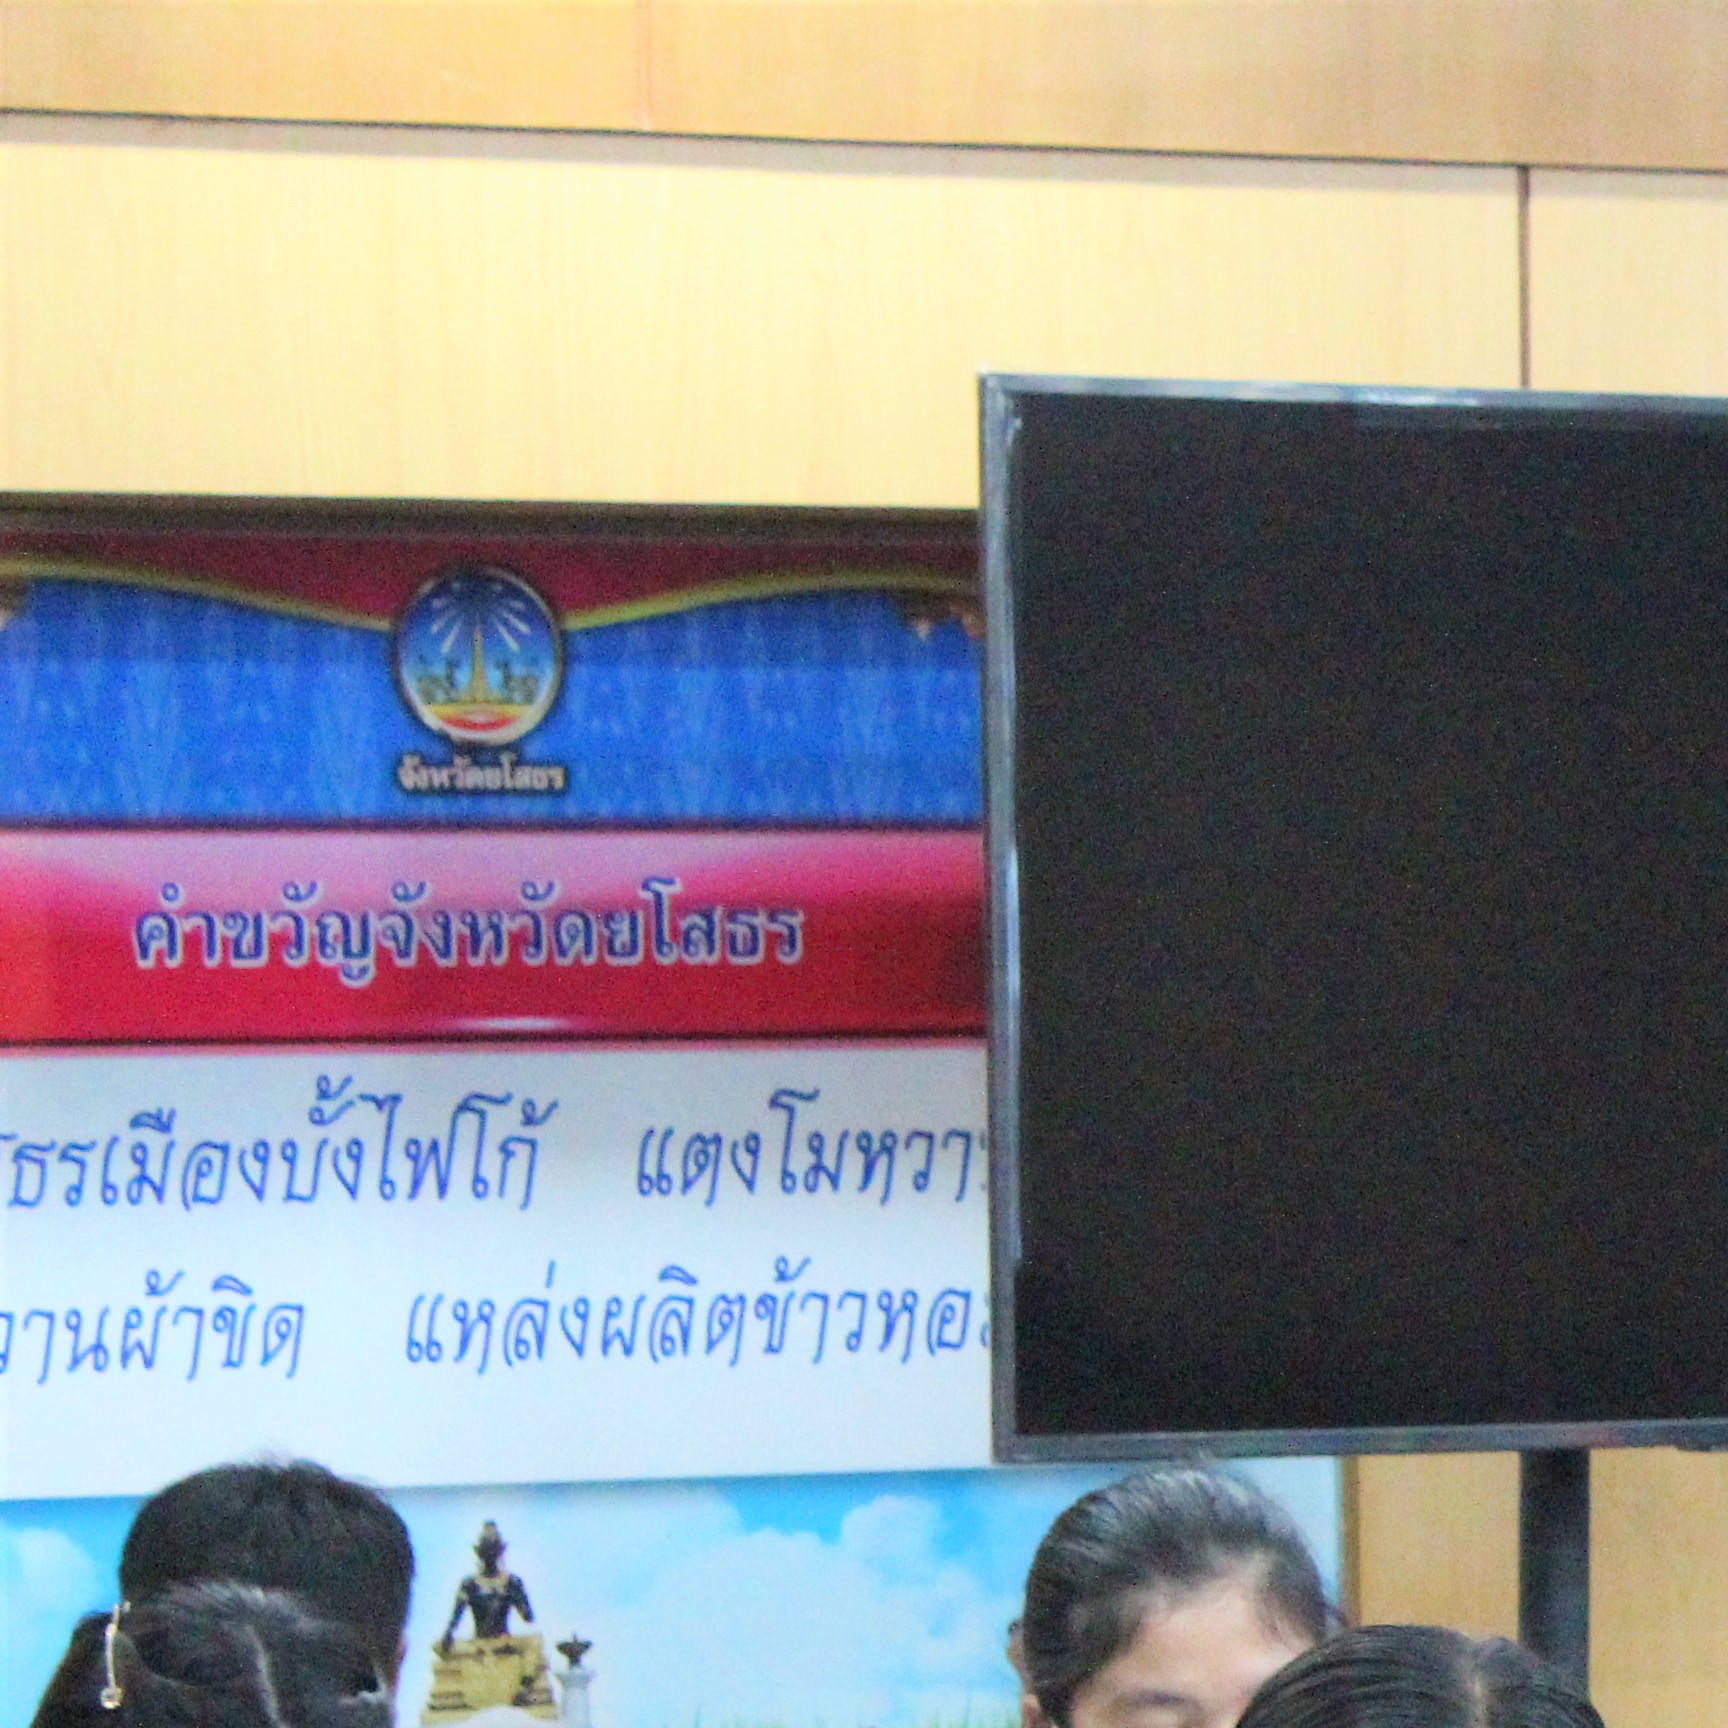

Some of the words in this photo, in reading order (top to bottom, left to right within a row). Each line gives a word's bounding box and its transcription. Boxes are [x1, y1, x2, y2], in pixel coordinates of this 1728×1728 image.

[134, 879, 803, 987] คำขวัญจังหวัดยโสธร
[0, 1074, 559, 1211] ธรเมืองบั้งไฟโก้
[637, 1089, 988, 1209] แตงโมหวา
[405, 1257, 989, 1376] แหล่งผลิตข้าวหอ
